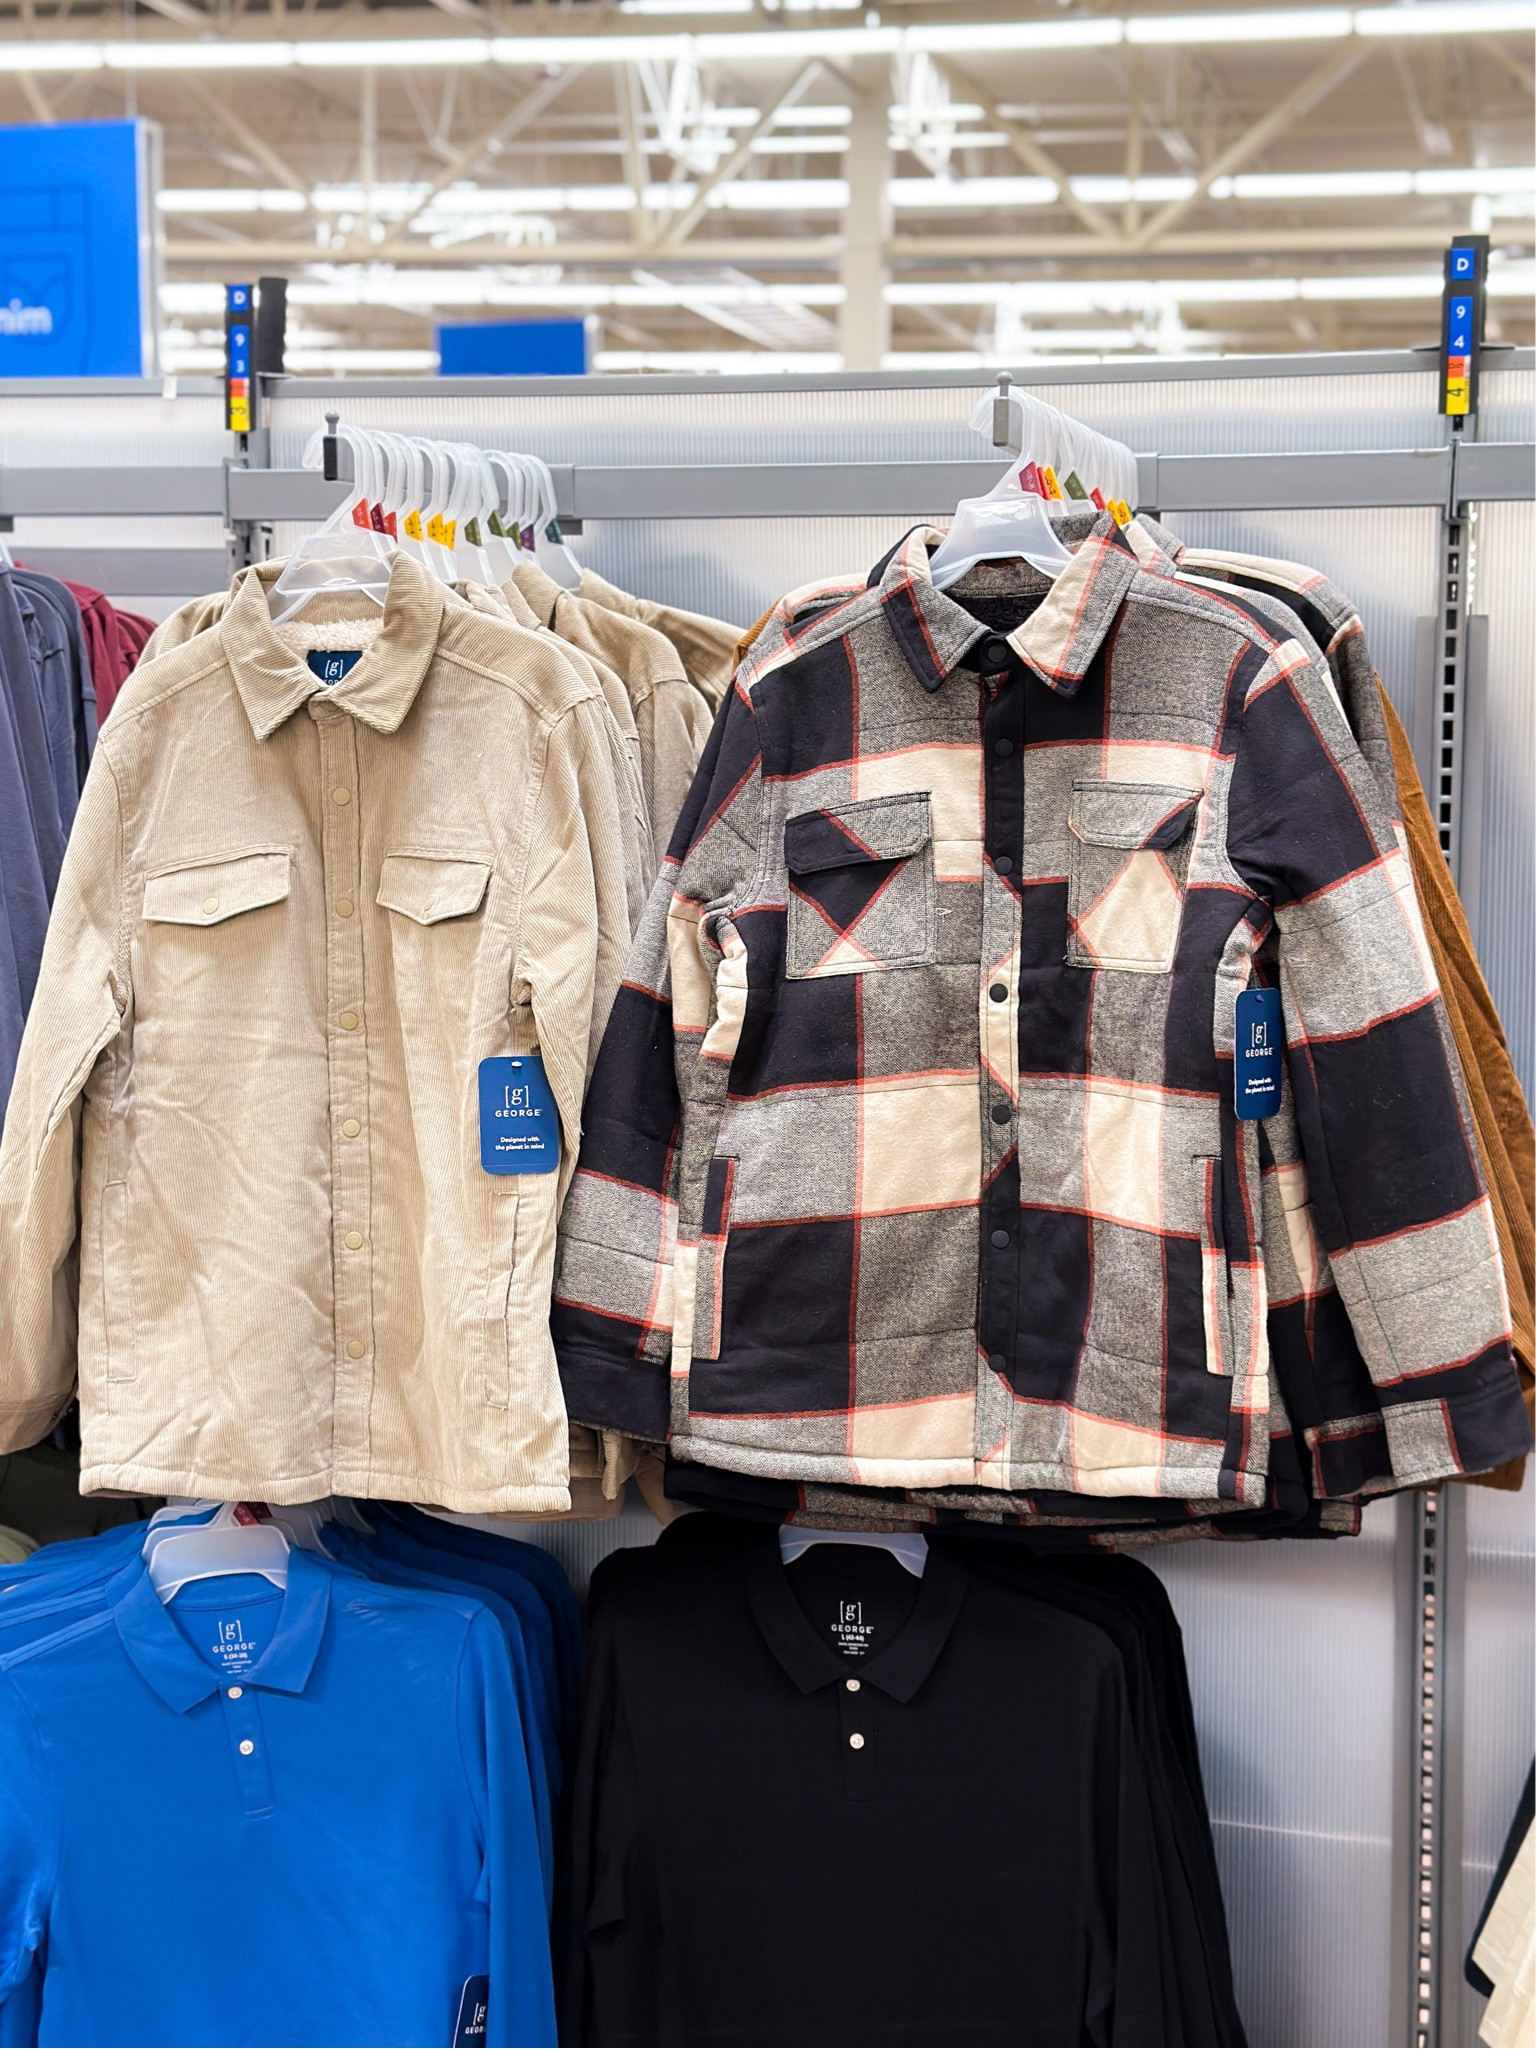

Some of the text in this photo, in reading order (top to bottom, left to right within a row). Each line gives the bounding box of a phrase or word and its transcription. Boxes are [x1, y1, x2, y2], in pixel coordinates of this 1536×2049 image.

[1456, 257, 1469, 272] D
[233, 290, 246, 305] D
[1447, 387, 1464, 397] 4
[1245, 1048, 1273, 1058] GEORGE
[495, 1109, 541, 1118] GEORGE
[500, 1136, 526, 1144] Designed
[831, 1624, 873, 1634] GEORGE
[212, 1643, 254, 1653] GEORGE
[472, 2002, 486, 2026] [g
[465, 2025, 486, 2035] GEOR
